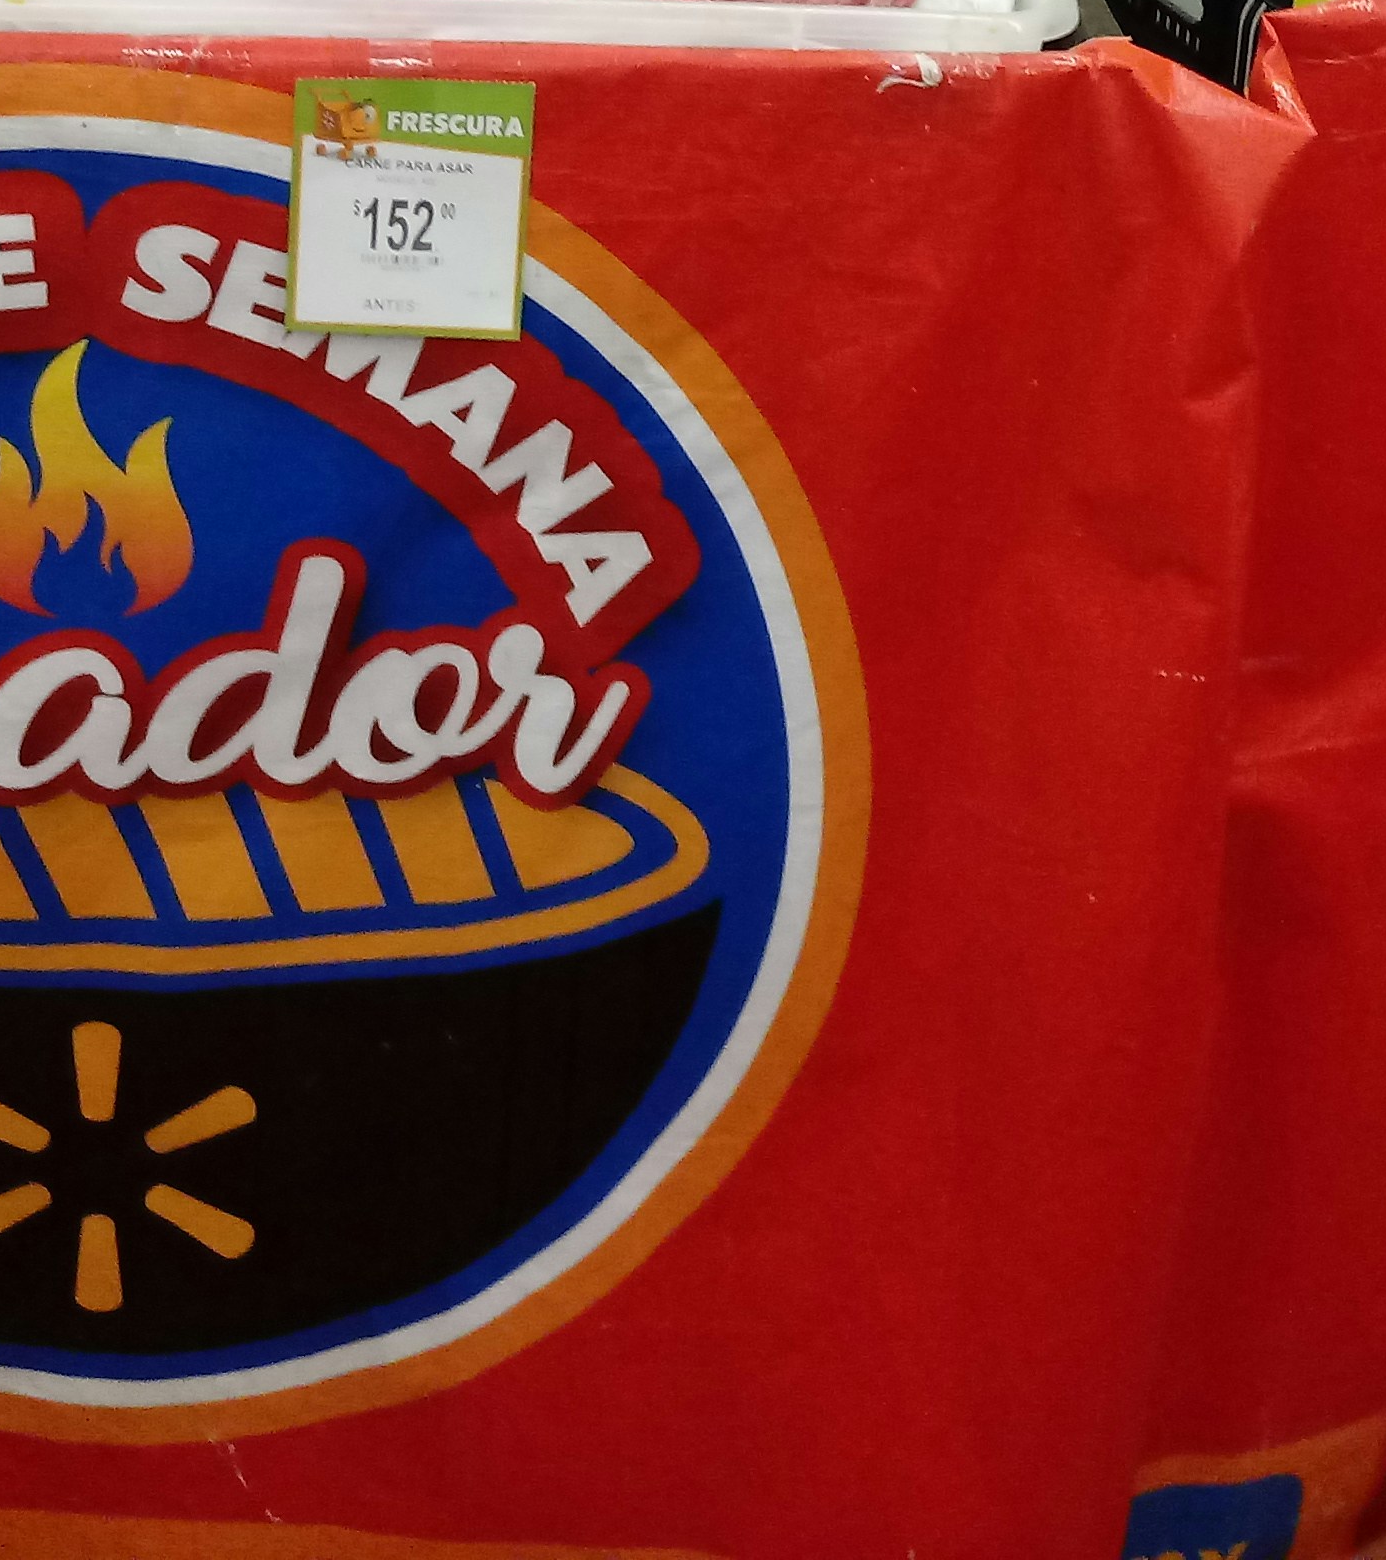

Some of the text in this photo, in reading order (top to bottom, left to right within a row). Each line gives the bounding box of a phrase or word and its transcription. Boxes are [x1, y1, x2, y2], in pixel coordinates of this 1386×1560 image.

[387, 110, 525, 138] FRESCURA
[345, 158, 474, 175] CARNE PARA ASAR
